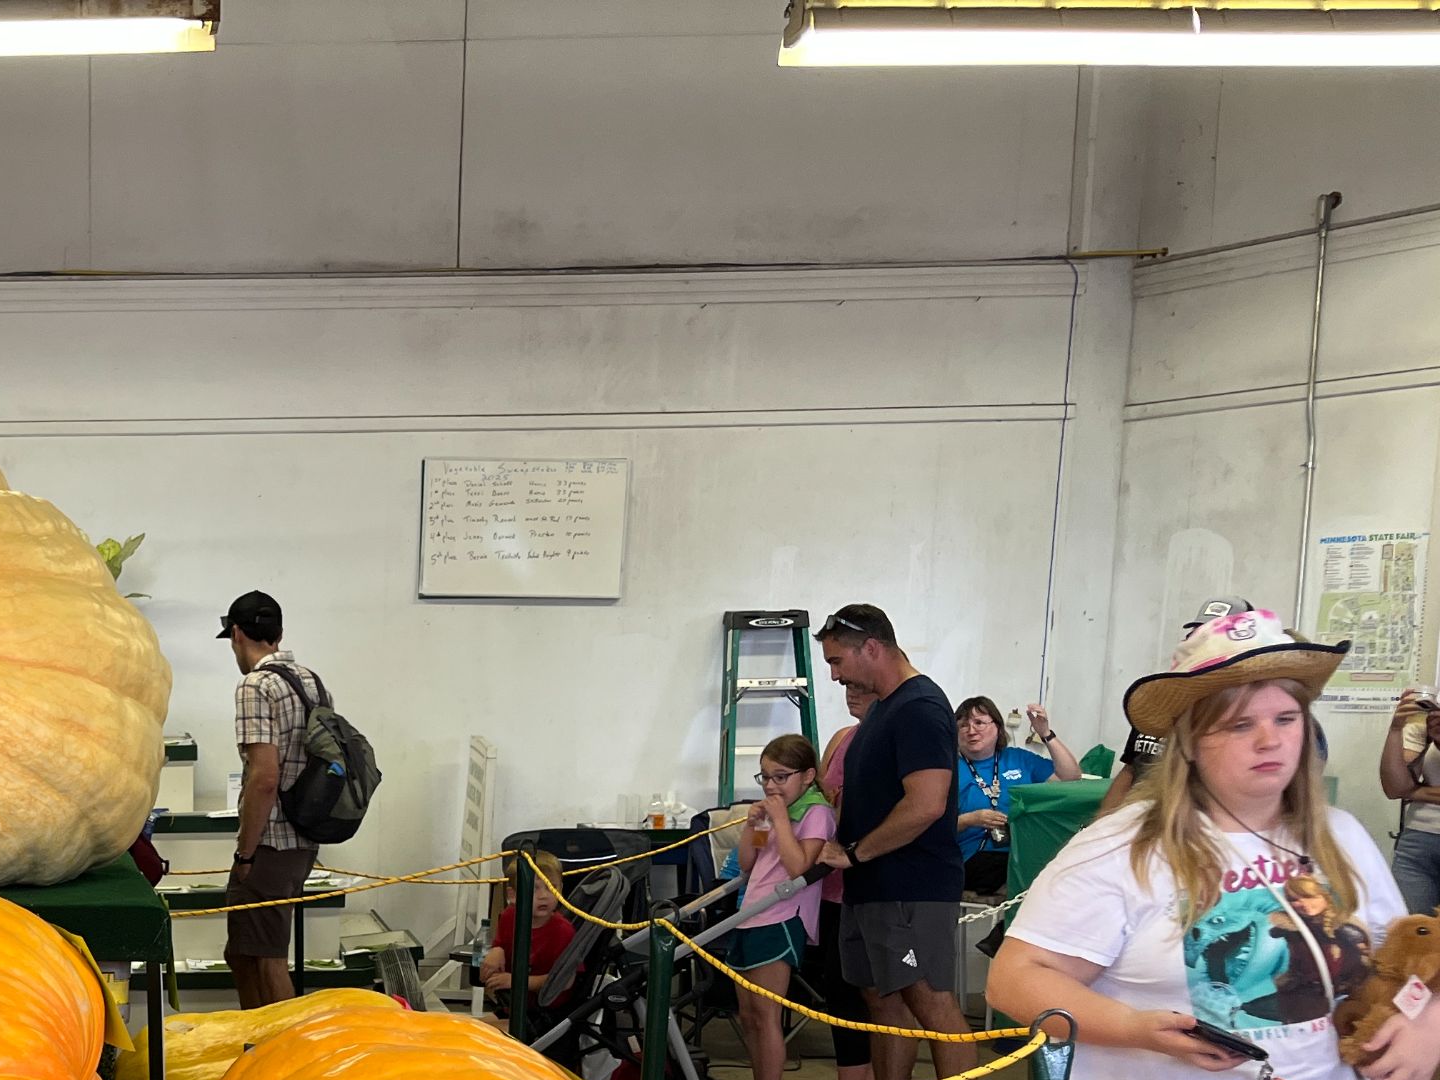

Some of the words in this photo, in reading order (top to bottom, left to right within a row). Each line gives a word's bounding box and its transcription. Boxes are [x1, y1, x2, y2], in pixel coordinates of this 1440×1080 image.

[443, 461, 485, 475] Vegetable
[1319, 535, 1367, 544] MINNESOTA
[1369, 533, 1394, 541] STATE
[1396, 532, 1416, 540] FAIR
[1134, 739, 1166, 755] ETTE
[1222, 854, 1313, 893] estie
